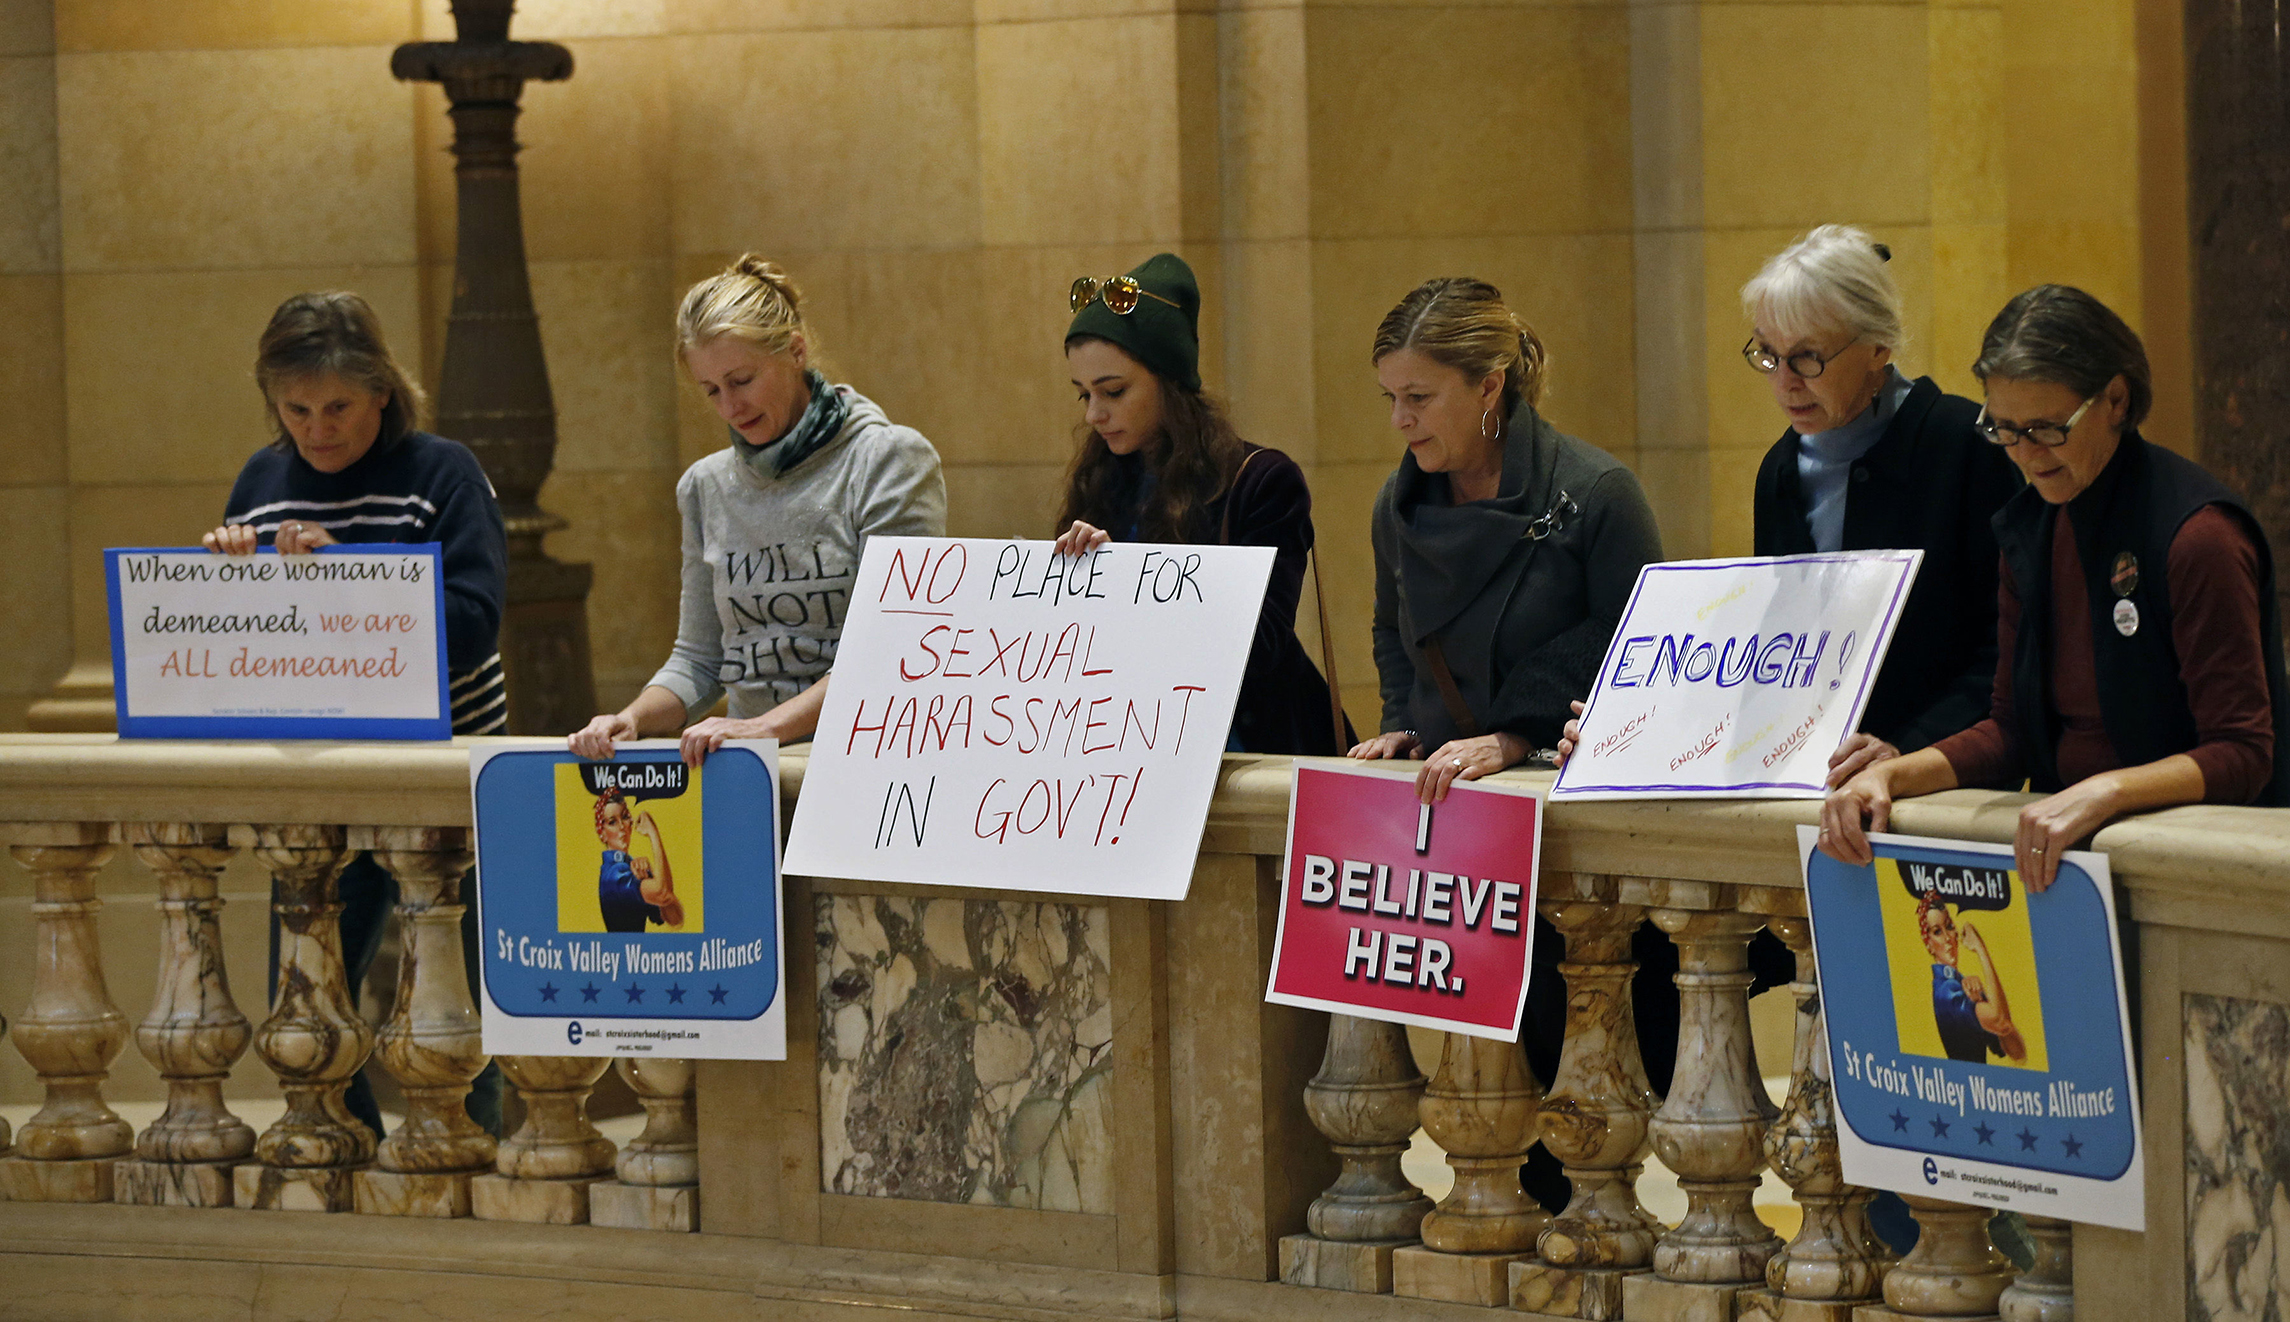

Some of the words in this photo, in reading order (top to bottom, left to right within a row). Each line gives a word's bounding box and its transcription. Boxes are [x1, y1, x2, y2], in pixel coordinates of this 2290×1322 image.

[127, 556, 214, 582] When
[219, 559, 279, 582] one
[284, 558, 395, 581] woman
[400, 557, 426, 583] is
[727, 541, 849, 585] WILL
[879, 543, 967, 605] NO
[989, 544, 1114, 606] PLACE
[1134, 551, 1203, 606] FOR
[144, 606, 308, 636] demeaned,
[320, 612, 361, 633] we
[365, 612, 418, 633] are
[728, 588, 846, 635] NOT
[160, 648, 218, 678] ALL
[230, 648, 408, 678] demeaned
[900, 622, 1114, 684] SEXUAL
[1611, 629, 1857, 690] ENOUGH!
[846, 685, 1207, 759] HARASSMENT
[1593, 705, 1656, 757] ENOUGH!
[1670, 713, 1731, 772] ENOUGH!
[1762, 704, 1824, 768] ENOUGH!
[593, 765, 617, 789] We
[617, 765, 643, 789] Can
[645, 765, 665, 788] Do
[667, 764, 683, 788] It!
[875, 776, 936, 849] IN
[974, 767, 1143, 847] GOV'T!
[1415, 803, 1430, 851] I
[1302, 854, 1521, 931] BELIEVE
[1910, 864, 1934, 891] We
[1934, 866, 1963, 895] Can
[1962, 869, 1985, 897] Do
[1985, 871, 2004, 899] It!
[498, 928, 514, 962] St
[519, 936, 562, 970] Croix
[568, 941, 620, 982] Valley
[625, 943, 694, 974] Womens
[699, 938, 762, 971] Alliance
[1345, 927, 1463, 992] HER.
[606, 1029, 700, 1041] stcroixsisterhood@gmail.com
[1843, 1041, 1860, 1080] St
[1865, 1052, 1910, 1097] Croix
[1912, 1065, 1965, 1117] Valley
[1968, 1075, 2043, 1117] Womens
[2049, 1081, 2116, 1118] Alliance
